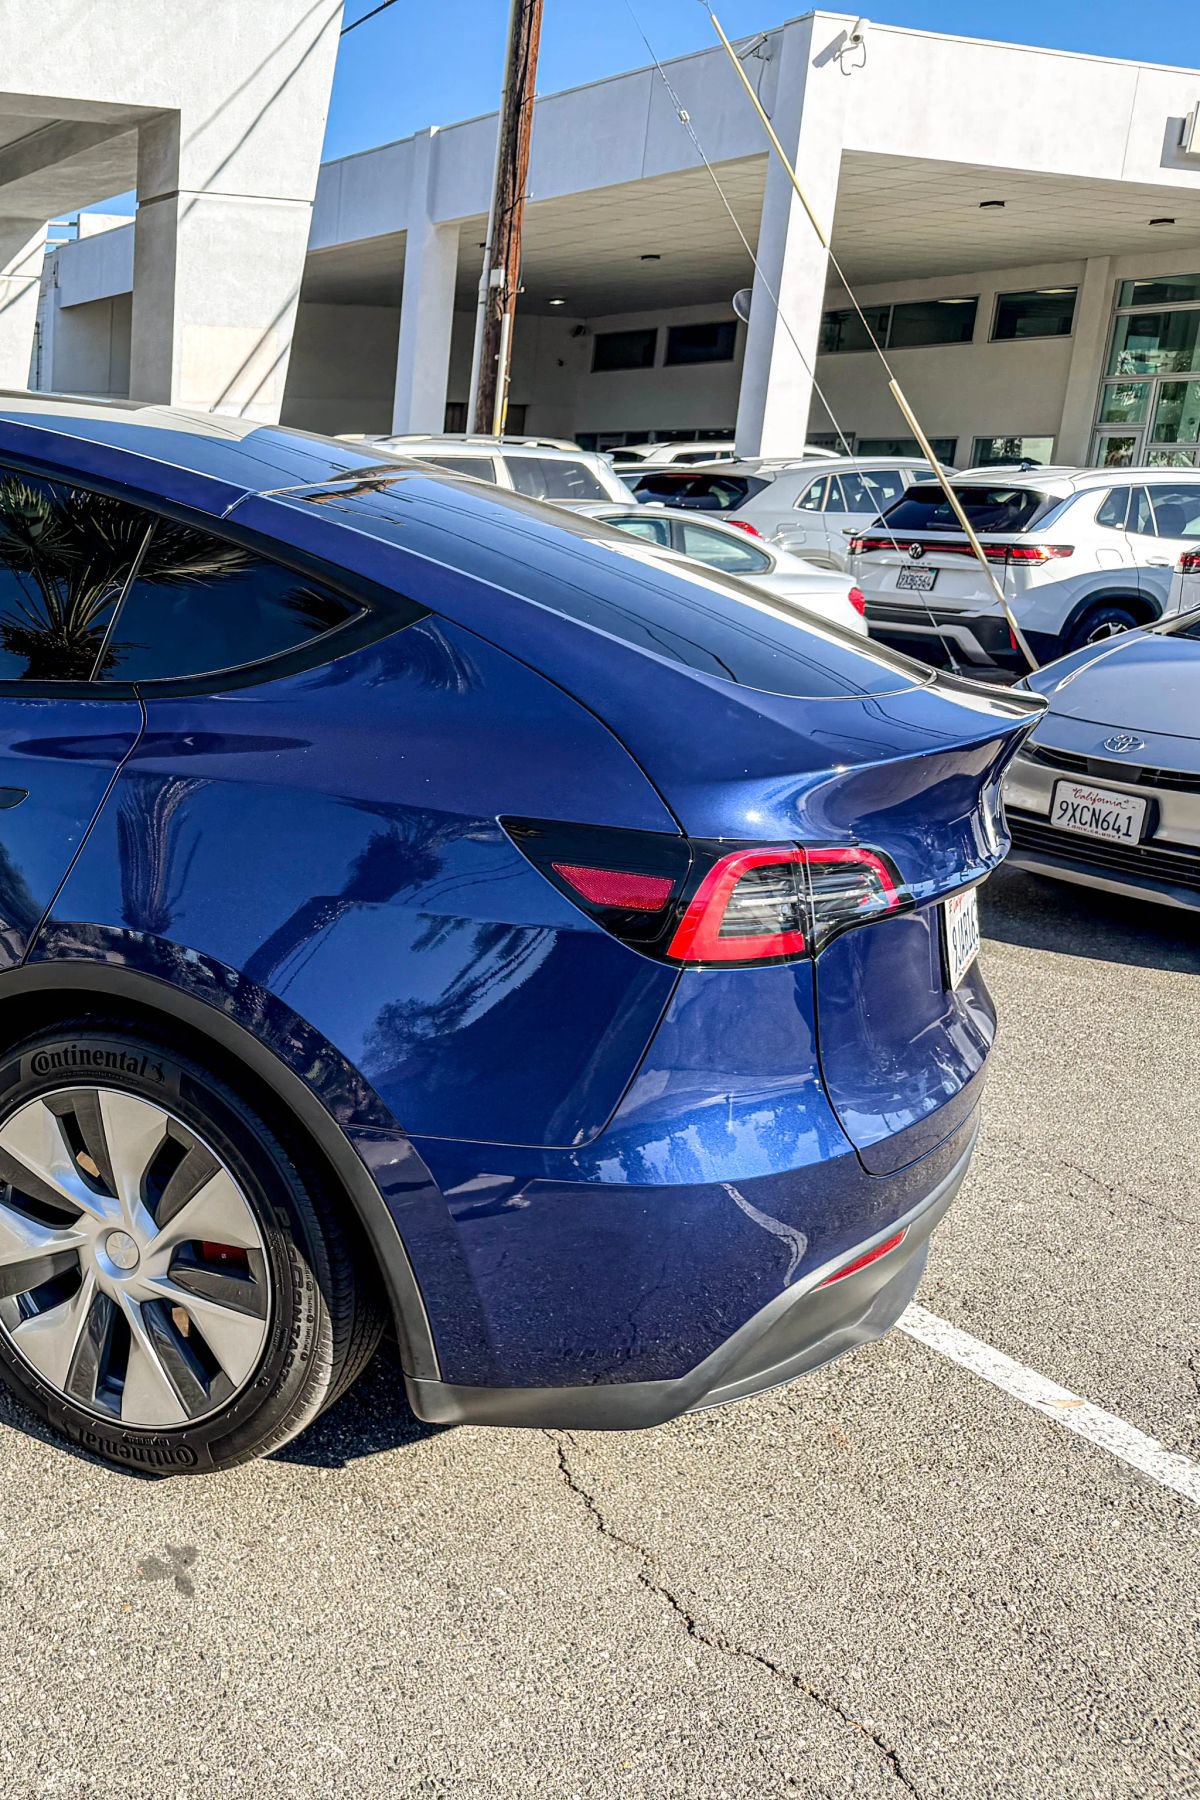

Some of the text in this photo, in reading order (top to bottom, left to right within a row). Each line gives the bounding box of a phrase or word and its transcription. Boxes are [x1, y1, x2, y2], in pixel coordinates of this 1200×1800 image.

[1073, 788, 1126, 808] California
[1057, 800, 1132, 838] 9XCN641
[30, 1043, 149, 1077] Continental
[78, 1427, 199, 1467] Continental
